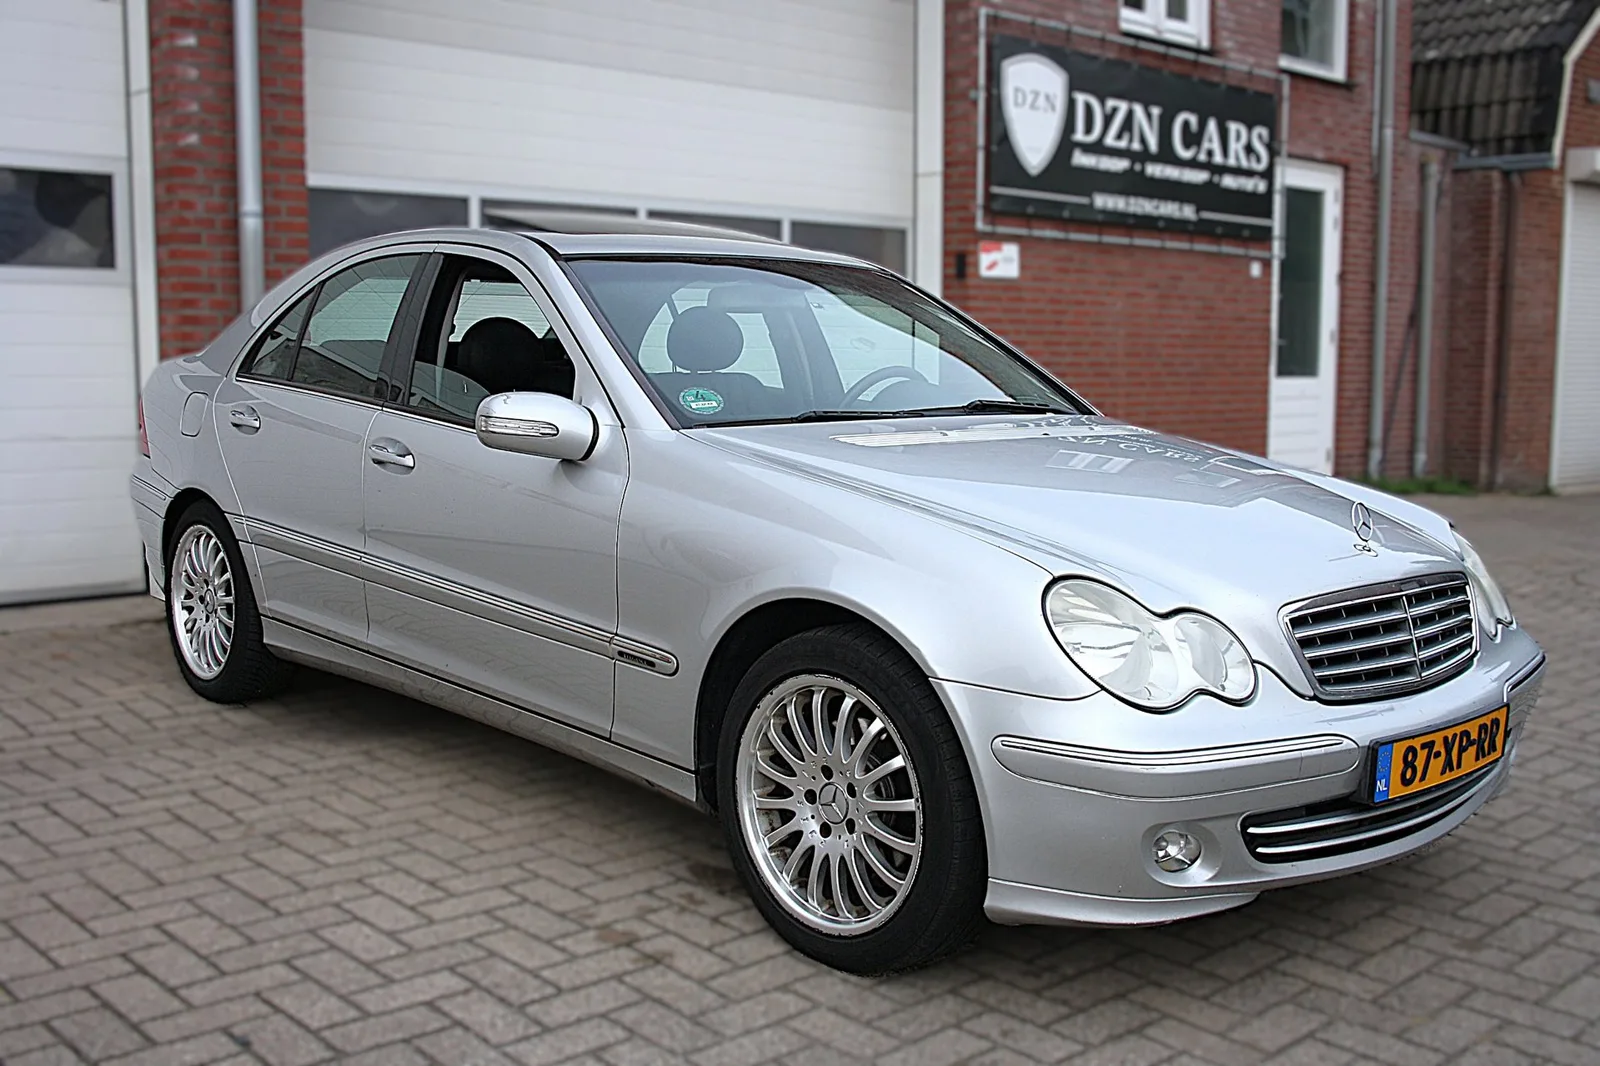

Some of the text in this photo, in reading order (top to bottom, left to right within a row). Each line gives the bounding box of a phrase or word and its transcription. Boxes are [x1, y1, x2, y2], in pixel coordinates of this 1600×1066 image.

[1013, 86, 1057, 113] DZN
[1071, 90, 1270, 172] DZN CARS
[1400, 717, 1500, 788] 87-XP-RR
[1376, 778, 1388, 793] NL
